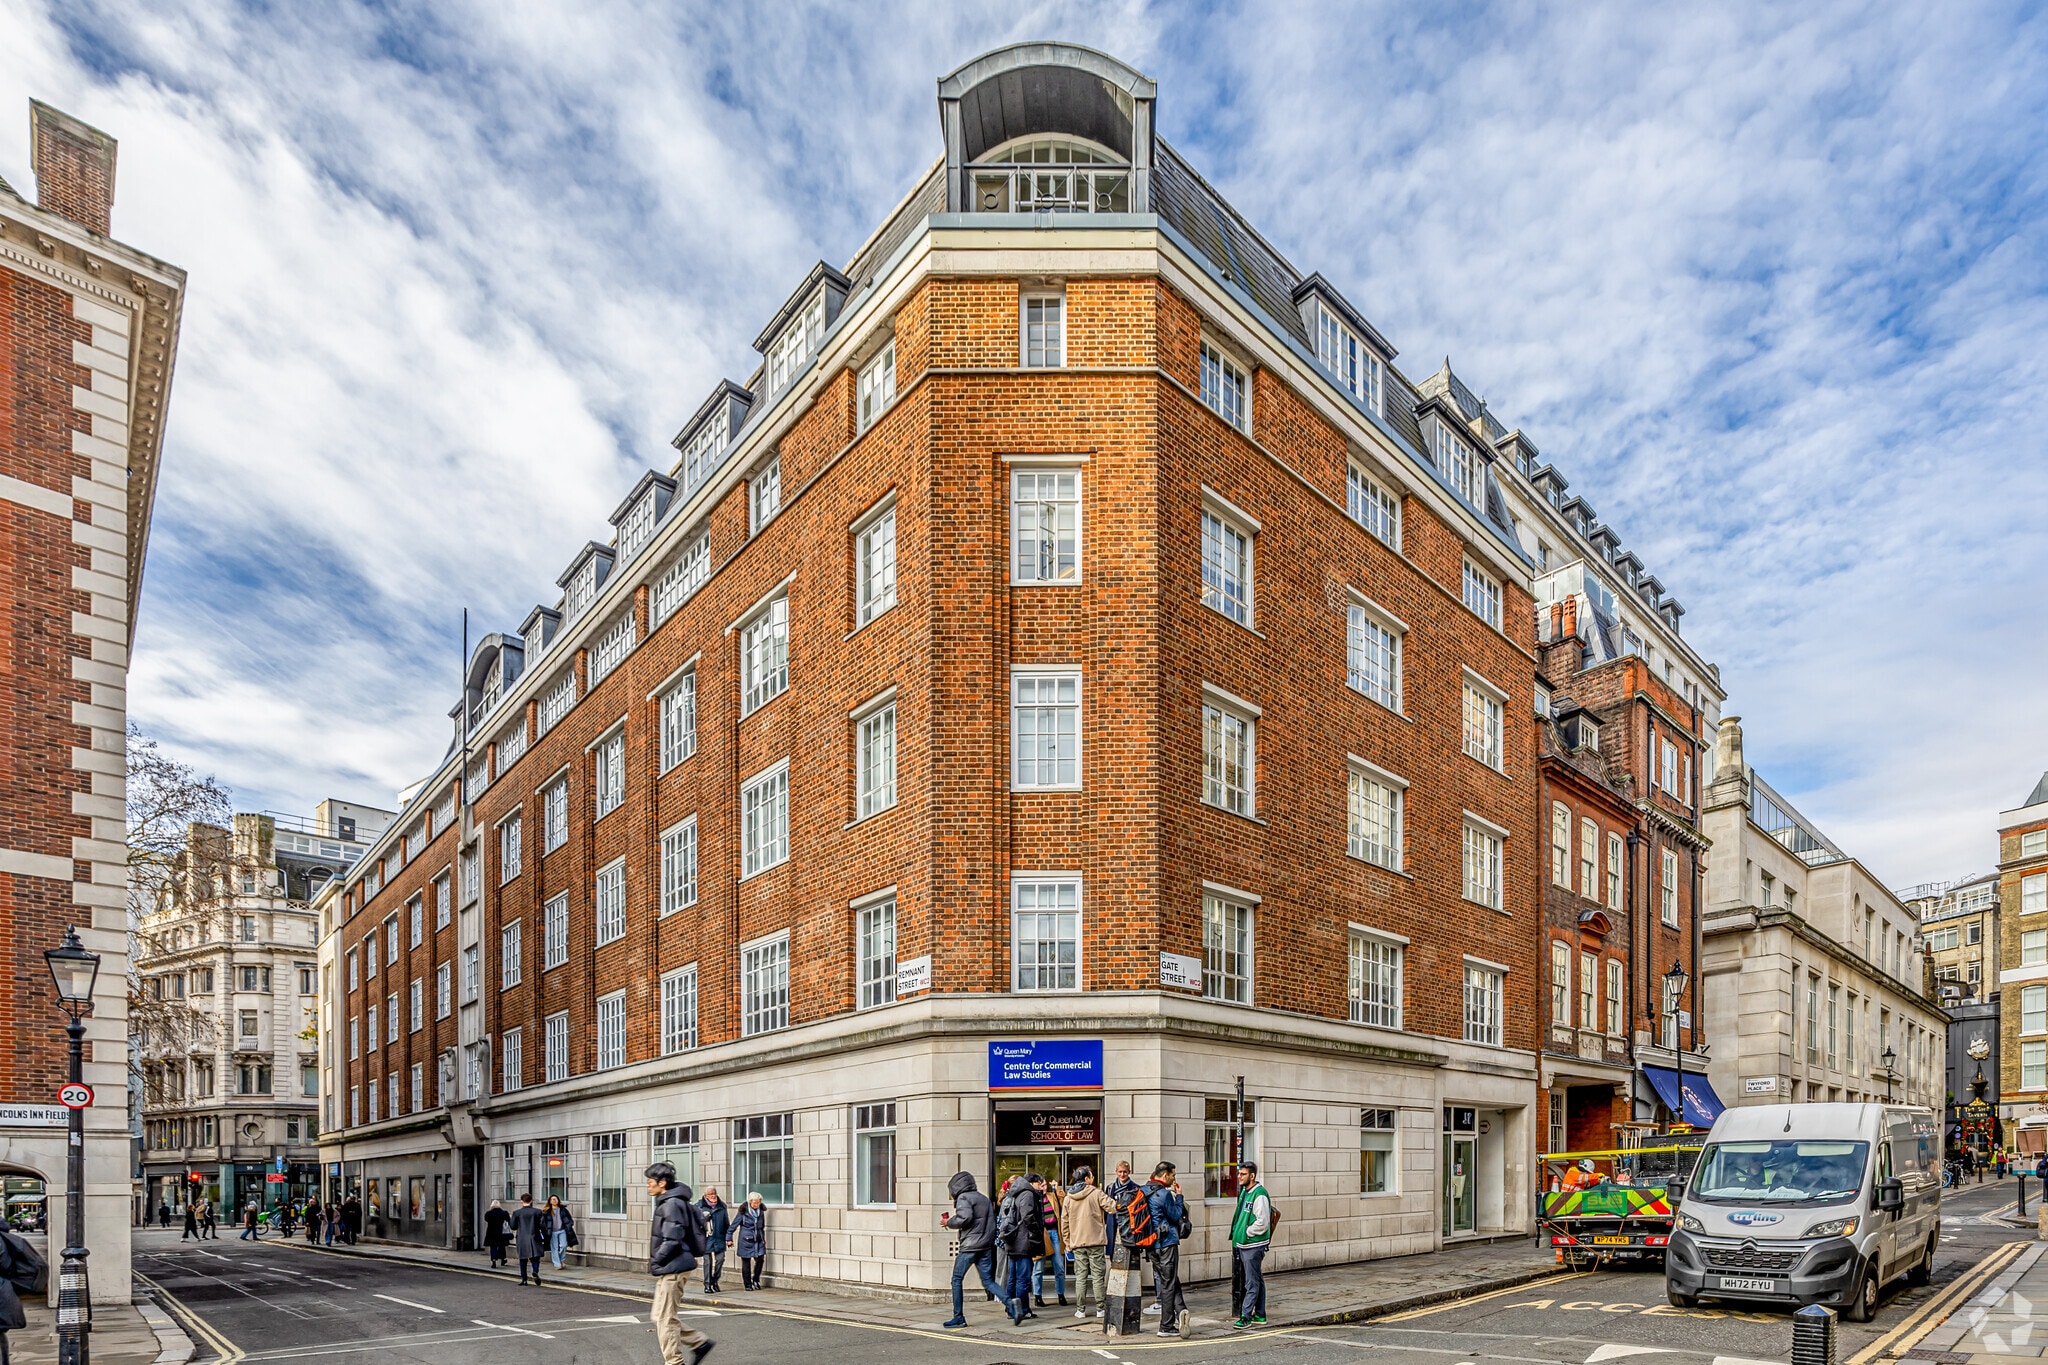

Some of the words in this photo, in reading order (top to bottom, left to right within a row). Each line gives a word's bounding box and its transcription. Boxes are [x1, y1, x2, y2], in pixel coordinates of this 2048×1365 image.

[1161, 961, 1179, 972] GATE
[898, 966, 925, 980] REMNANT
[898, 979, 918, 991] STREET
[1161, 972, 1186, 984] STREET
[1189, 979, 1201, 987] WC2
[1020, 1048, 1032, 1056] Mary
[1004, 1062, 1031, 1071] Centre
[1032, 1061, 1044, 1070] for
[1044, 1060, 1092, 1070] Commercial
[1004, 1071, 1021, 1080] Law
[1022, 1070, 1051, 1079] Studies
[63, 1090, 88, 1102] 20
[29, 1110, 44, 1119] INN
[1049, 1115, 1074, 1124] Queen
[1074, 1115, 1094, 1125] Mary
[1030, 1132, 1063, 1140] SCHOOL
[1064, 1132, 1075, 1140] OF
[1077, 1132, 1094, 1140] LAW
[1733, 1213, 1777, 1222] truline
[1724, 1279, 1749, 1288] MH72
[1751, 1280, 1771, 1290] FYU
[1503, 1299, 1794, 1323] ACCESS
